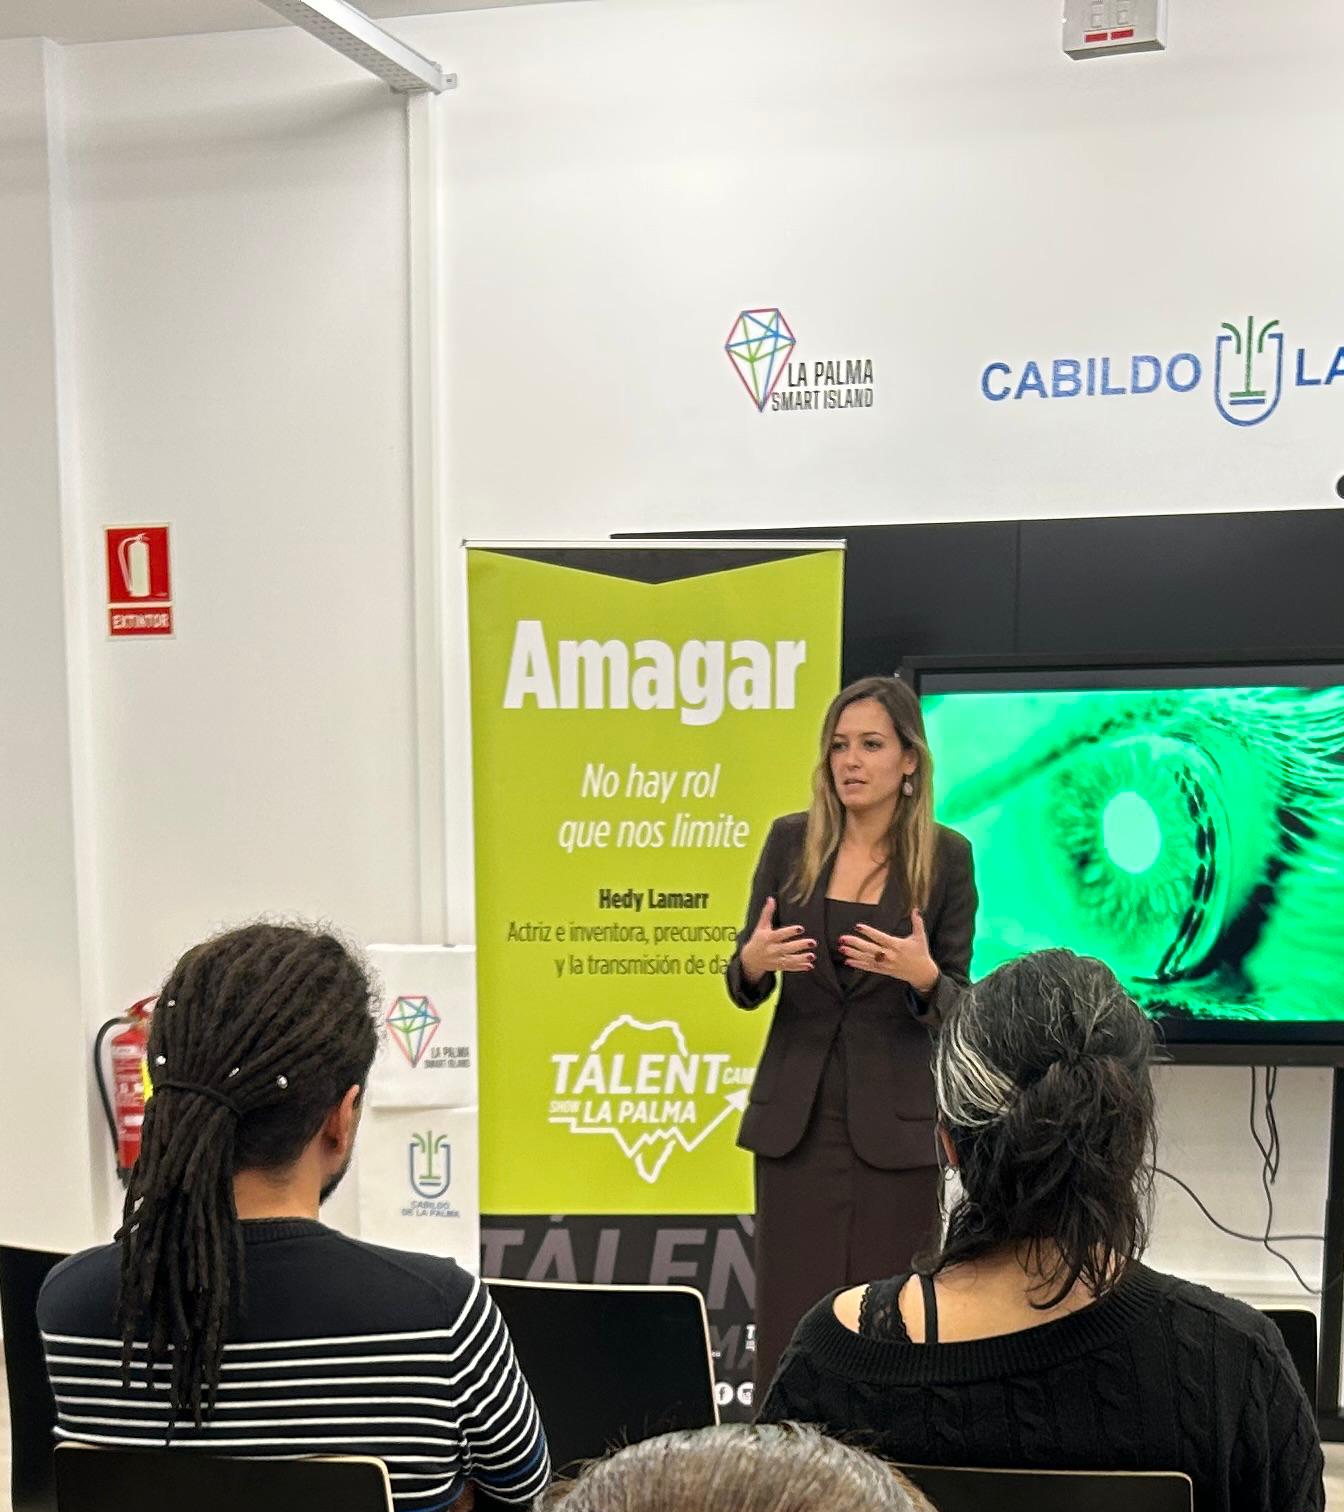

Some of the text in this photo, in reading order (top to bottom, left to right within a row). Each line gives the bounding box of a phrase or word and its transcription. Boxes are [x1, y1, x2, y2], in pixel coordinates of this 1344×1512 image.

[787, 358, 874, 387] LA PALMA
[981, 352, 1203, 402] CABILDO
[771, 388, 874, 412] SMART ISLAND
[502, 619, 807, 726] Amagar
[581, 763, 722, 804] No hay rol
[558, 812, 751, 854] que nos limite
[598, 888, 709, 912] Hedy Lamarr
[507, 920, 738, 945] Actriz e inventora, precursora
[554, 958, 565, 978] y
[568, 953, 584, 975] la
[588, 953, 682, 976] transmisión
[684, 954, 706, 976] de
[583, 1100, 612, 1123] LA
[618, 1100, 697, 1124] PALMA
